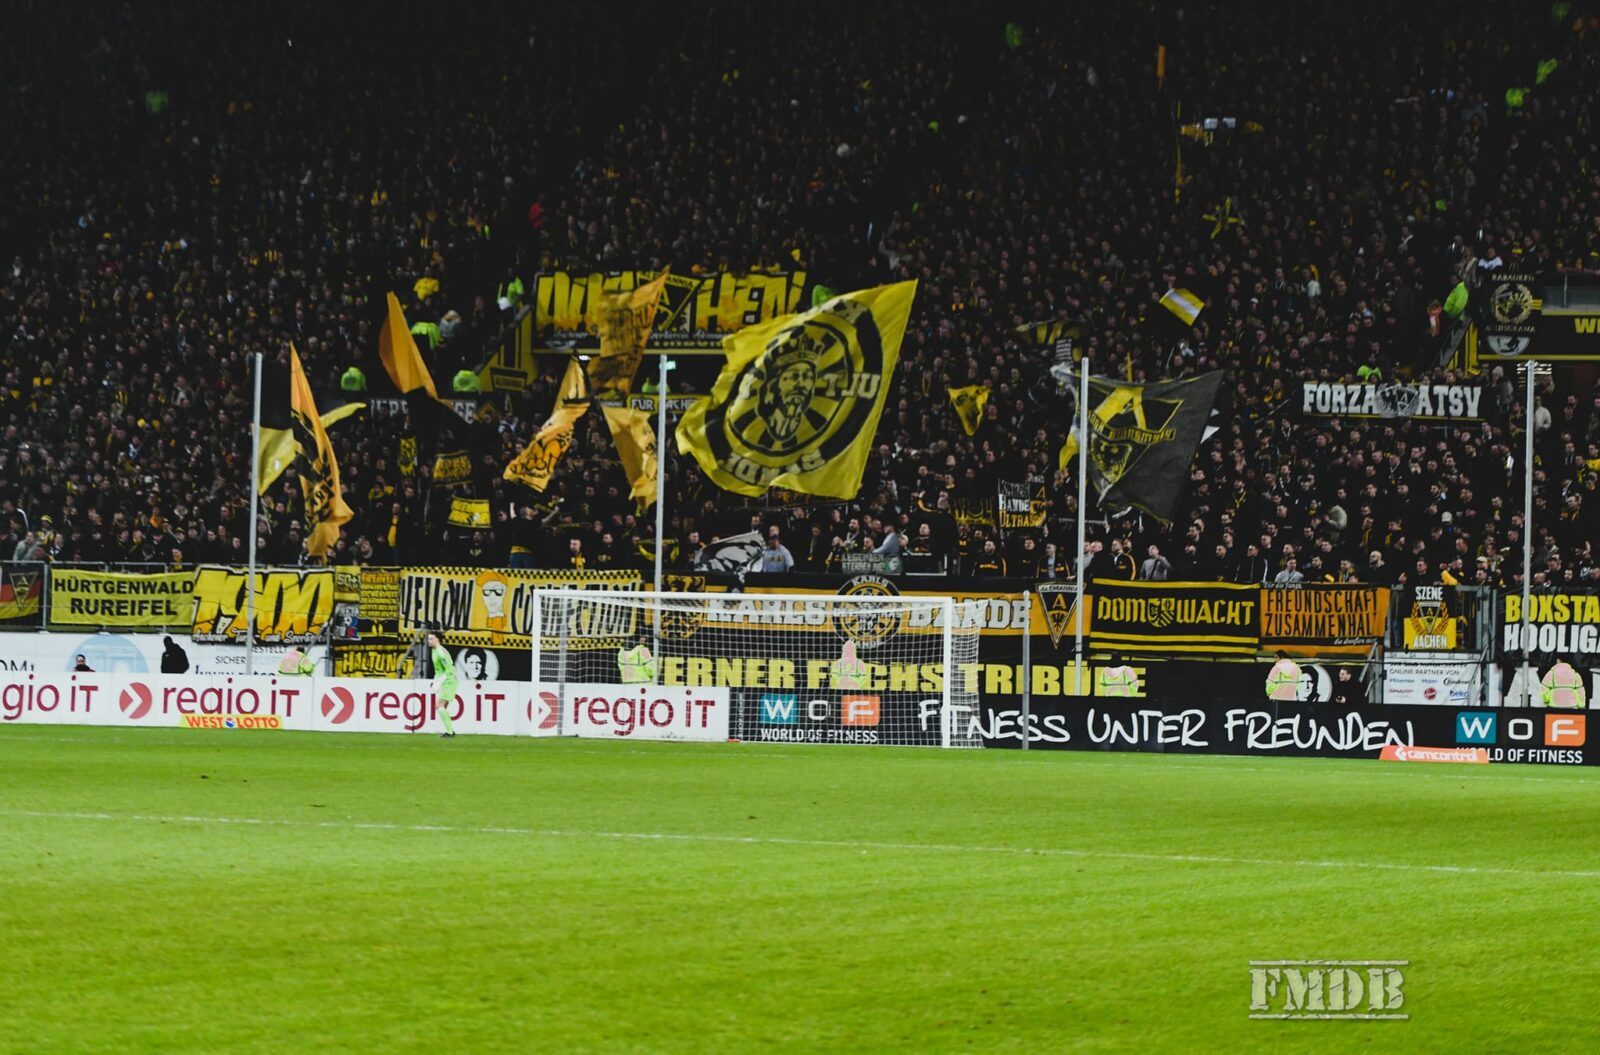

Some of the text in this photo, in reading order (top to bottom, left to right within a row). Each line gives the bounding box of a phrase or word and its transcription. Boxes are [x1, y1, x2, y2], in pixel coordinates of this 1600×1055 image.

[1303, 383, 1481, 418] FORZA ATSV
[54, 577, 194, 595] HÜRTGENWALD
[1415, 586, 1443, 601] SZENE
[70, 597, 177, 617] RUREIFEL
[401, 576, 474, 631] YELLOW
[1413, 634, 1448, 649] AACHEN
[807, 659, 943, 693] FCHS
[573, 688, 673, 736] regio
[186, 716, 280, 729] WEST LOTTO
[1087, 708, 1209, 747] UNTER
[1224, 709, 1415, 751] FREUNDEN
[761, 728, 804, 741] WORLD
[827, 730, 878, 743] FITNESS
[1507, 748, 1524, 762] OF
[1528, 750, 1583, 764] FITNESS
